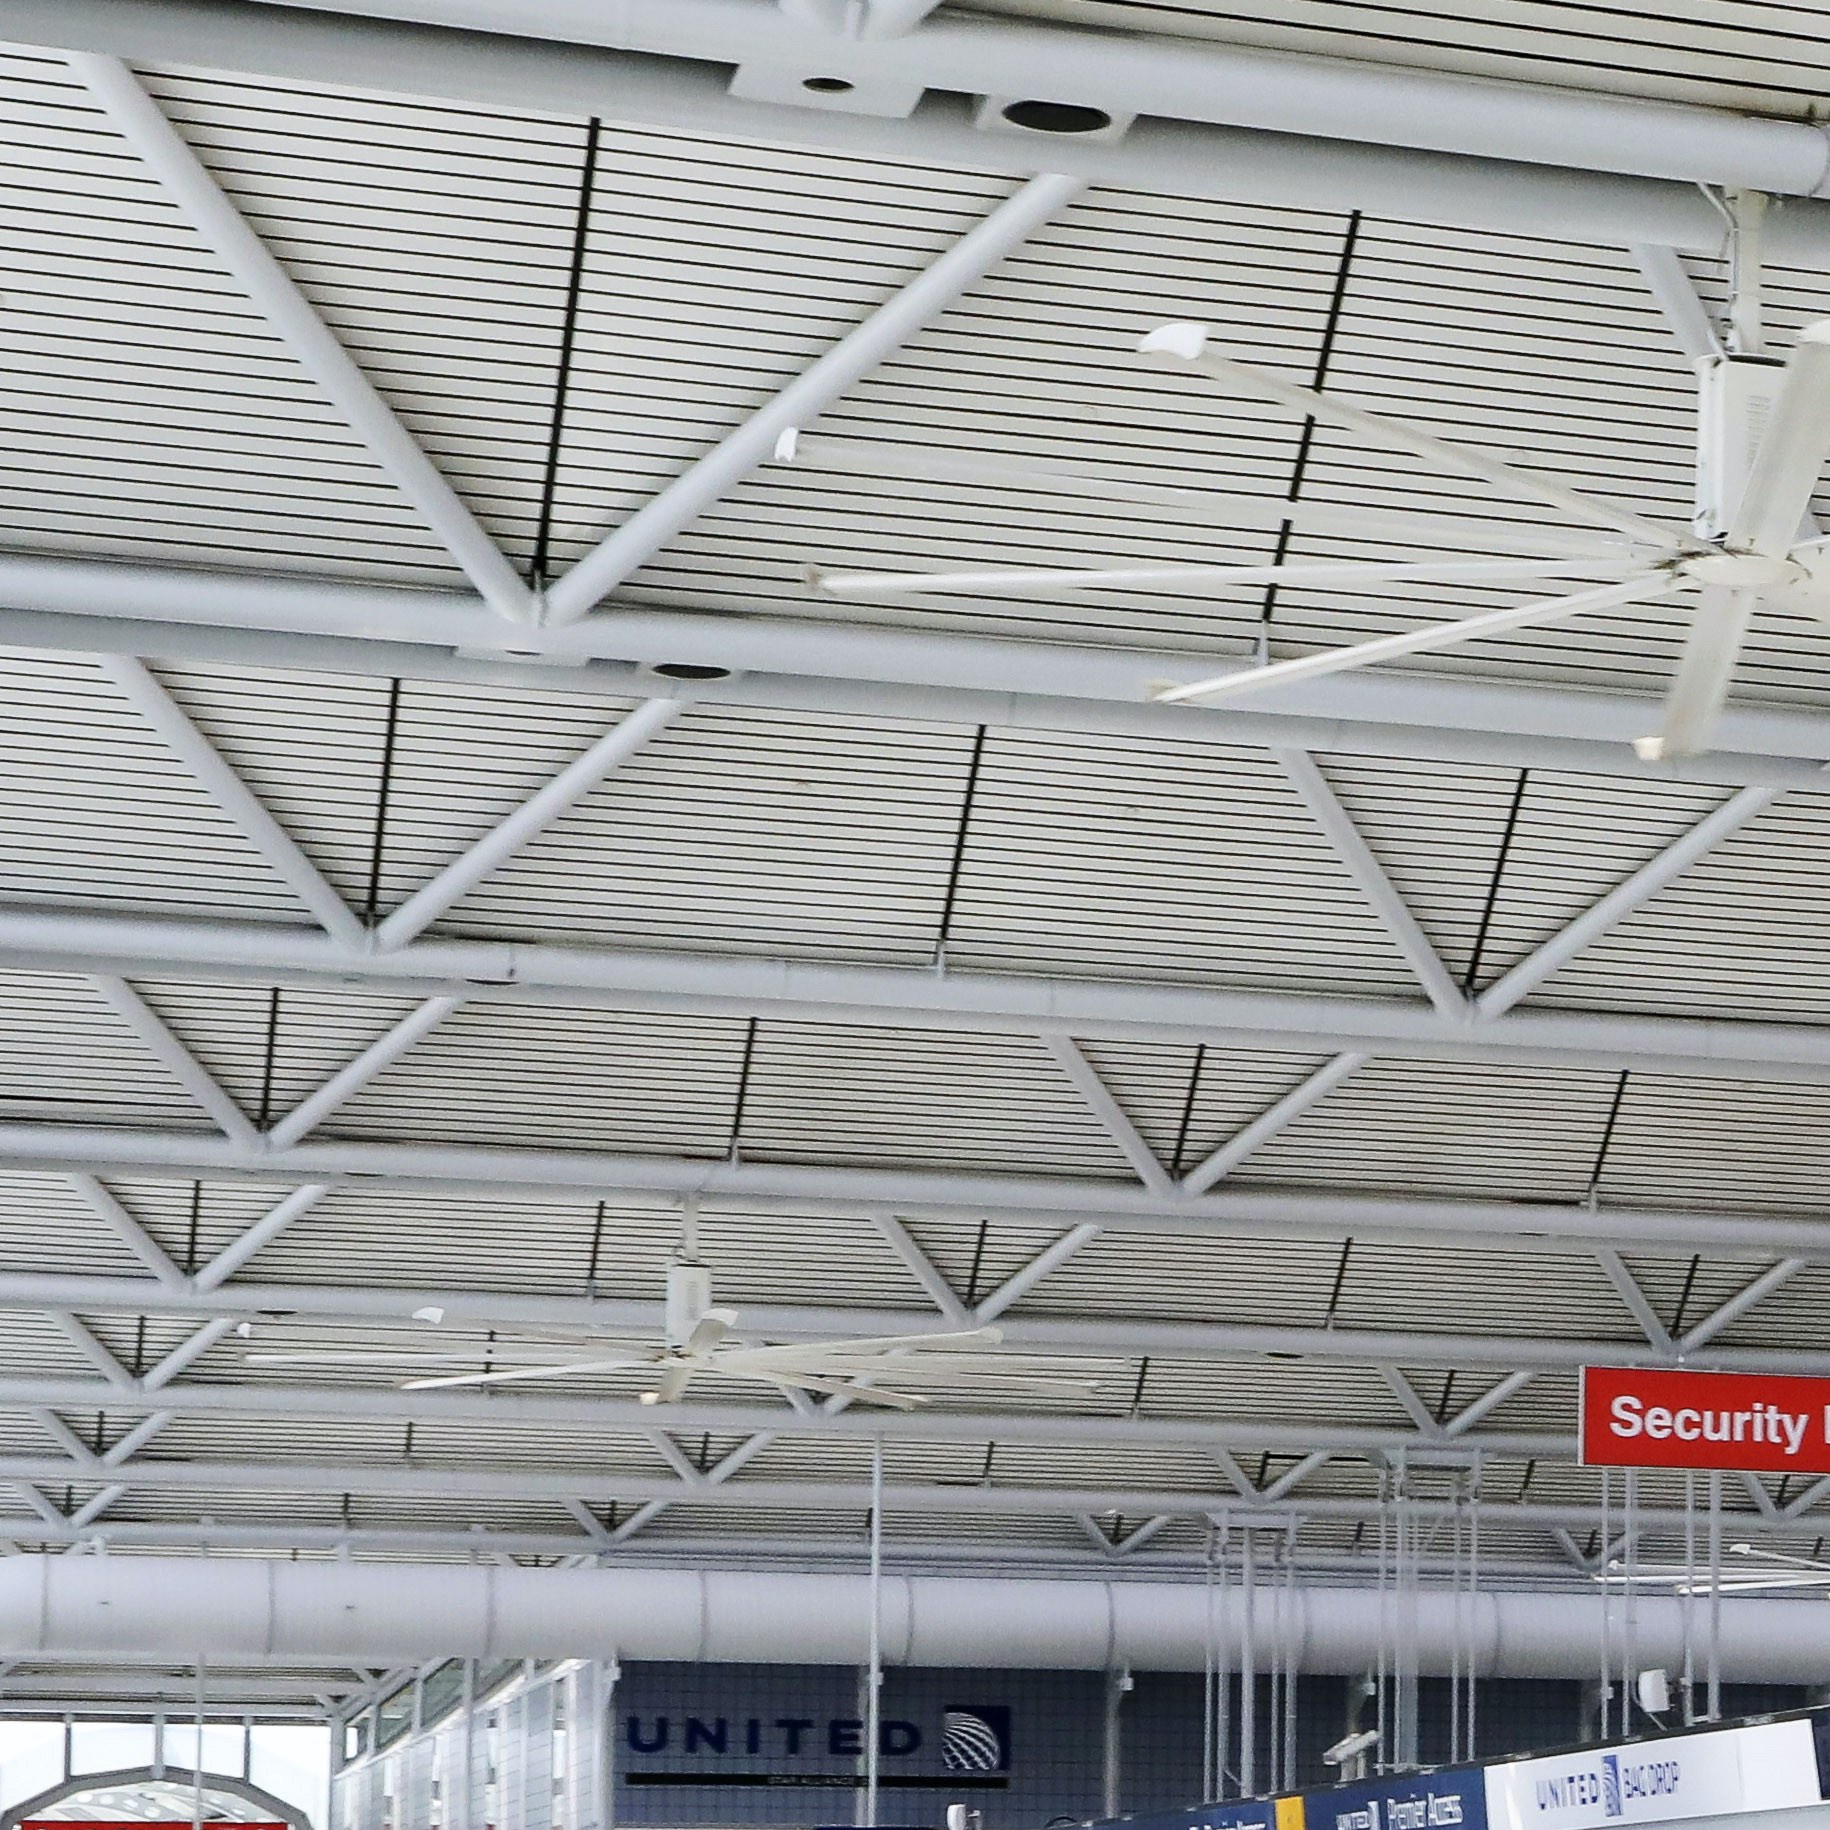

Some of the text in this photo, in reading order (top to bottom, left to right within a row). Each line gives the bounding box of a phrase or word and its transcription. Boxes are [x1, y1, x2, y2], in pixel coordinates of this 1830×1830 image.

[1609, 1395, 1808, 1454] Security
[626, 1716, 922, 1755] UNITED
[1536, 1772, 1599, 1811] UNITED
